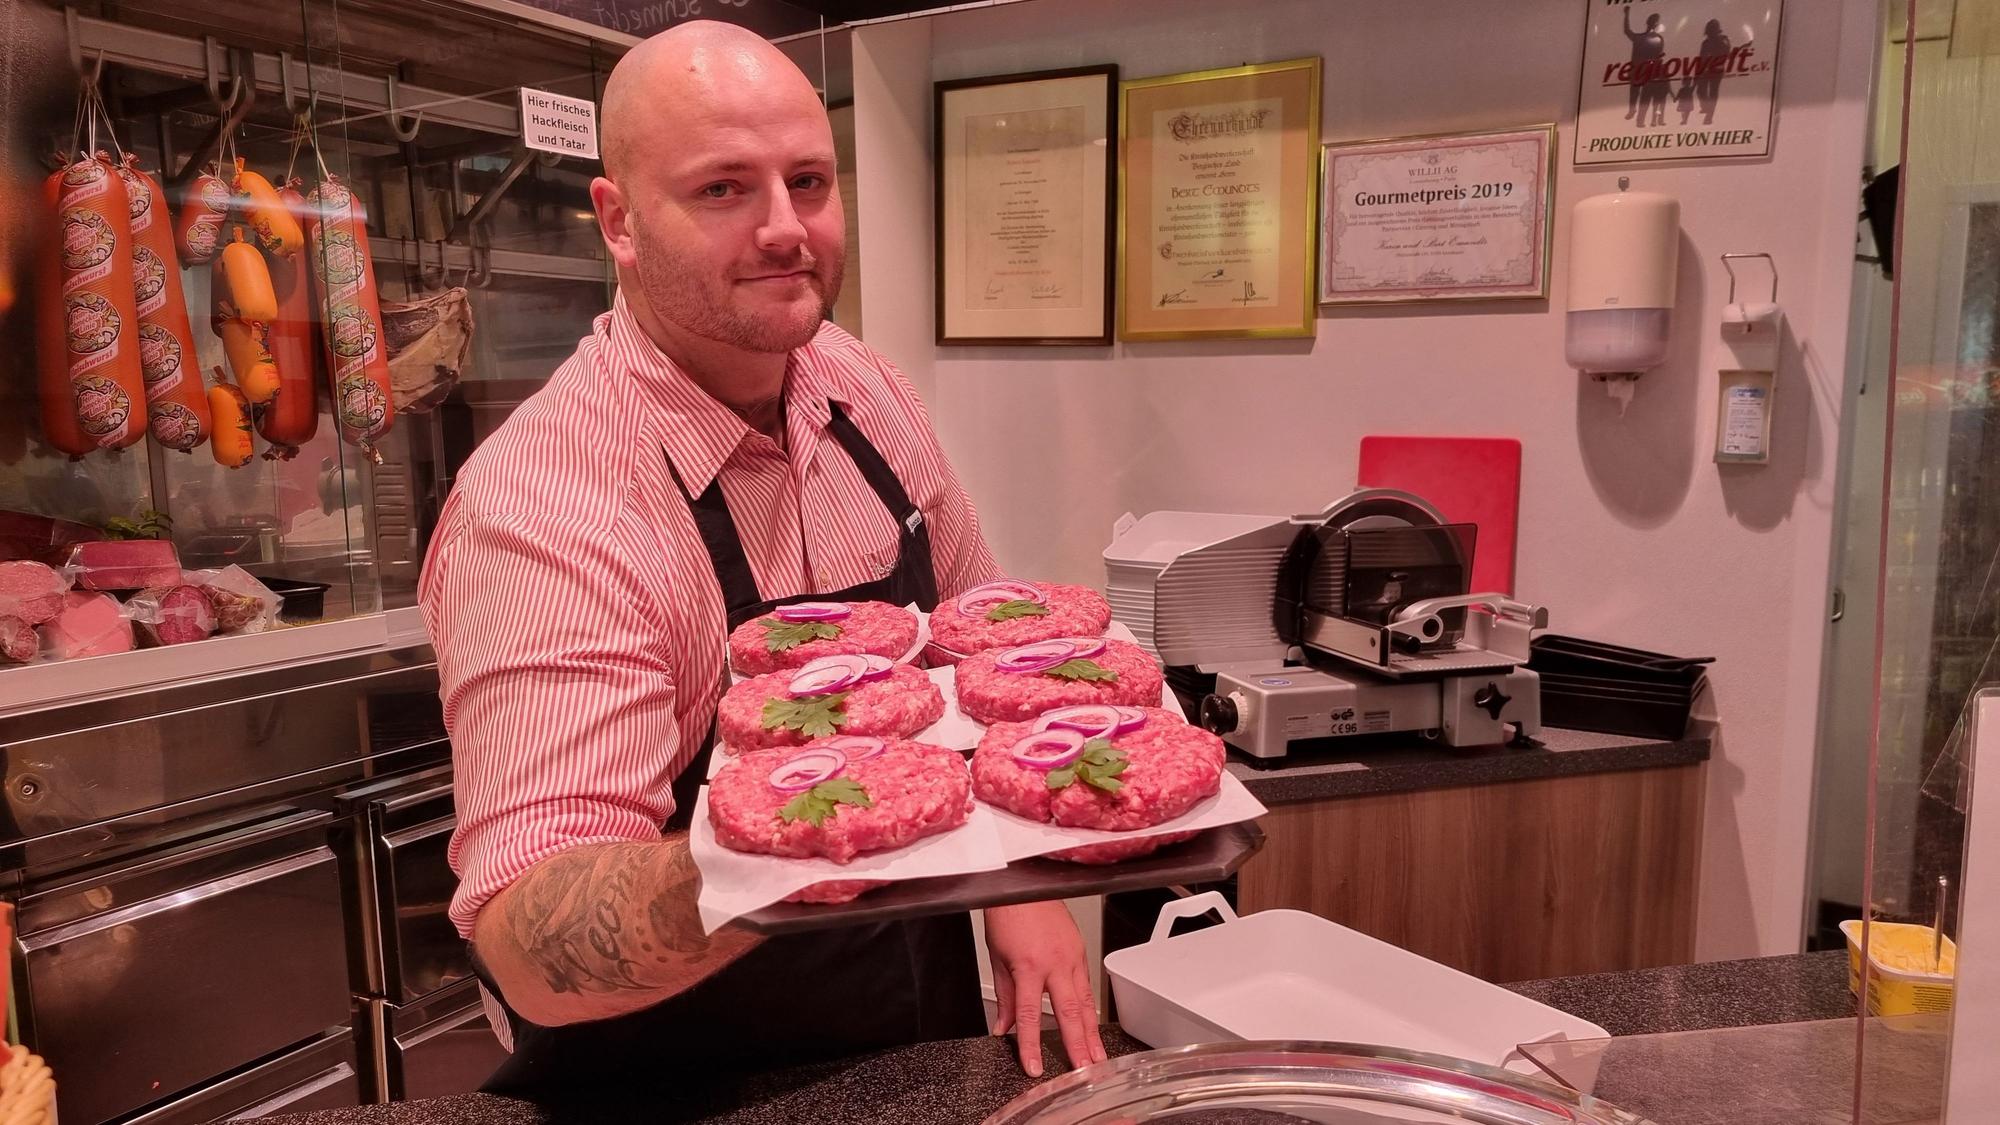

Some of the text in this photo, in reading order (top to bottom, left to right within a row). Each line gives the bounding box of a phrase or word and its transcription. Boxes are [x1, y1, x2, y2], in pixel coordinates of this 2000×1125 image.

[1603, 42, 1755, 85] regiowelt
[528, 95, 591, 118] Hier frisches
[532, 114, 589, 134] Hackfleisch
[538, 134, 586, 150] und Tatar
[1589, 133, 1673, 152] PRODUKTE
[1677, 131, 1710, 148] VON
[1712, 129, 1754, 145] HIER
[1445, 165, 1458, 175] AG
[1355, 181, 1513, 207] Gourmetpreis 2019
[131, 219, 148, 232] urst
[136, 298, 161, 318] wurst
[1345, 722, 1358, 733] 96
